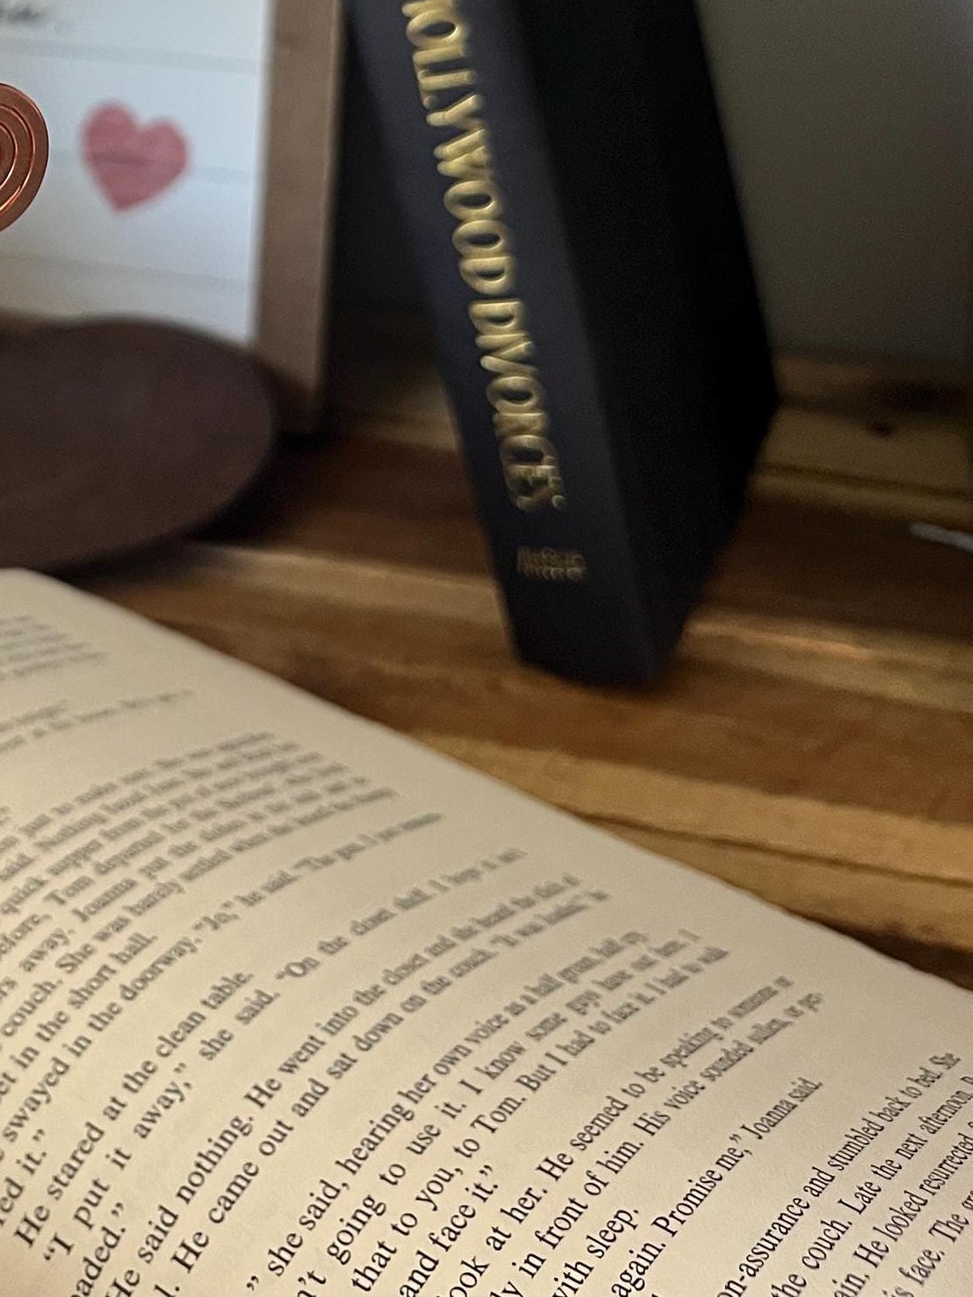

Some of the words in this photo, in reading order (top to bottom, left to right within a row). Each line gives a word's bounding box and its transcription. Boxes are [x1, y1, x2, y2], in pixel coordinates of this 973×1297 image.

[468, 298, 566, 511] DIVORCES
[0, 979, 63, 1037] couch.
[35, 1010, 70, 1043] the
[2, 1057, 70, 1143] swayed
[13, 1204, 50, 1248] He
[47, 1121, 105, 1201] stared
[123, 1060, 159, 1094] the
[155, 1010, 206, 1058] clean
[200, 972, 254, 1010] table.
[73, 1178, 110, 1231] put
[199, 1028, 234, 1061] she
[138, 1204, 179, 1264] said
[176, 1114, 254, 1205] nothing.
[244, 1077, 282, 1109] He
[279, 1034, 327, 1076] went
[315, 1005, 360, 1037] into
[170, 1231, 210, 1274] He
[208, 1160, 259, 1225] came
[258, 1119, 295, 1157] out
[291, 1077, 330, 1118] and
[327, 1052, 358, 1079] sat
[354, 1012, 404, 1052] down
[267, 1232, 304, 1277] she
[298, 1179, 350, 1231] said,
[335, 1102, 416, 1176] hearing
[397, 1073, 438, 1104] her
[432, 1043, 473, 1077] own
[327, 1194, 387, 1266] going
[406, 1123, 442, 1156] use
[475, 1040, 527, 1080] know
[351, 1239, 398, 1292] that
[391, 1212, 419, 1237] to
[415, 1166, 464, 1212] you,
[470, 1096, 527, 1134] Tom.
[515, 1064, 557, 1092] But
[485, 1227, 512, 1251] at
[500, 1187, 549, 1224] her.
[536, 1150, 575, 1182] He
[569, 1094, 629, 1152] seemed
[634, 1064, 666, 1084] be
[534, 1196, 590, 1250] front
[596, 1142, 644, 1175] him.
[633, 1109, 672, 1137] His
[664, 1079, 706, 1110] voice
[828, 1118, 884, 1171] stumbled
[875, 1097, 912, 1122] back
[428, 1202, 477, 1253] face
[586, 1205, 641, 1258] sleep.
[611, 1241, 667, 1297] again.
[651, 1168, 724, 1238] Promise
[740, 1099, 798, 1140] Joanna
[801, 1218, 853, 1270] couch.
[837, 1181, 882, 1215] Late
[894, 1132, 929, 1160] next
[873, 1190, 929, 1242] looked
[898, 1247, 946, 1287] face.
[928, 1212, 970, 1243] The
